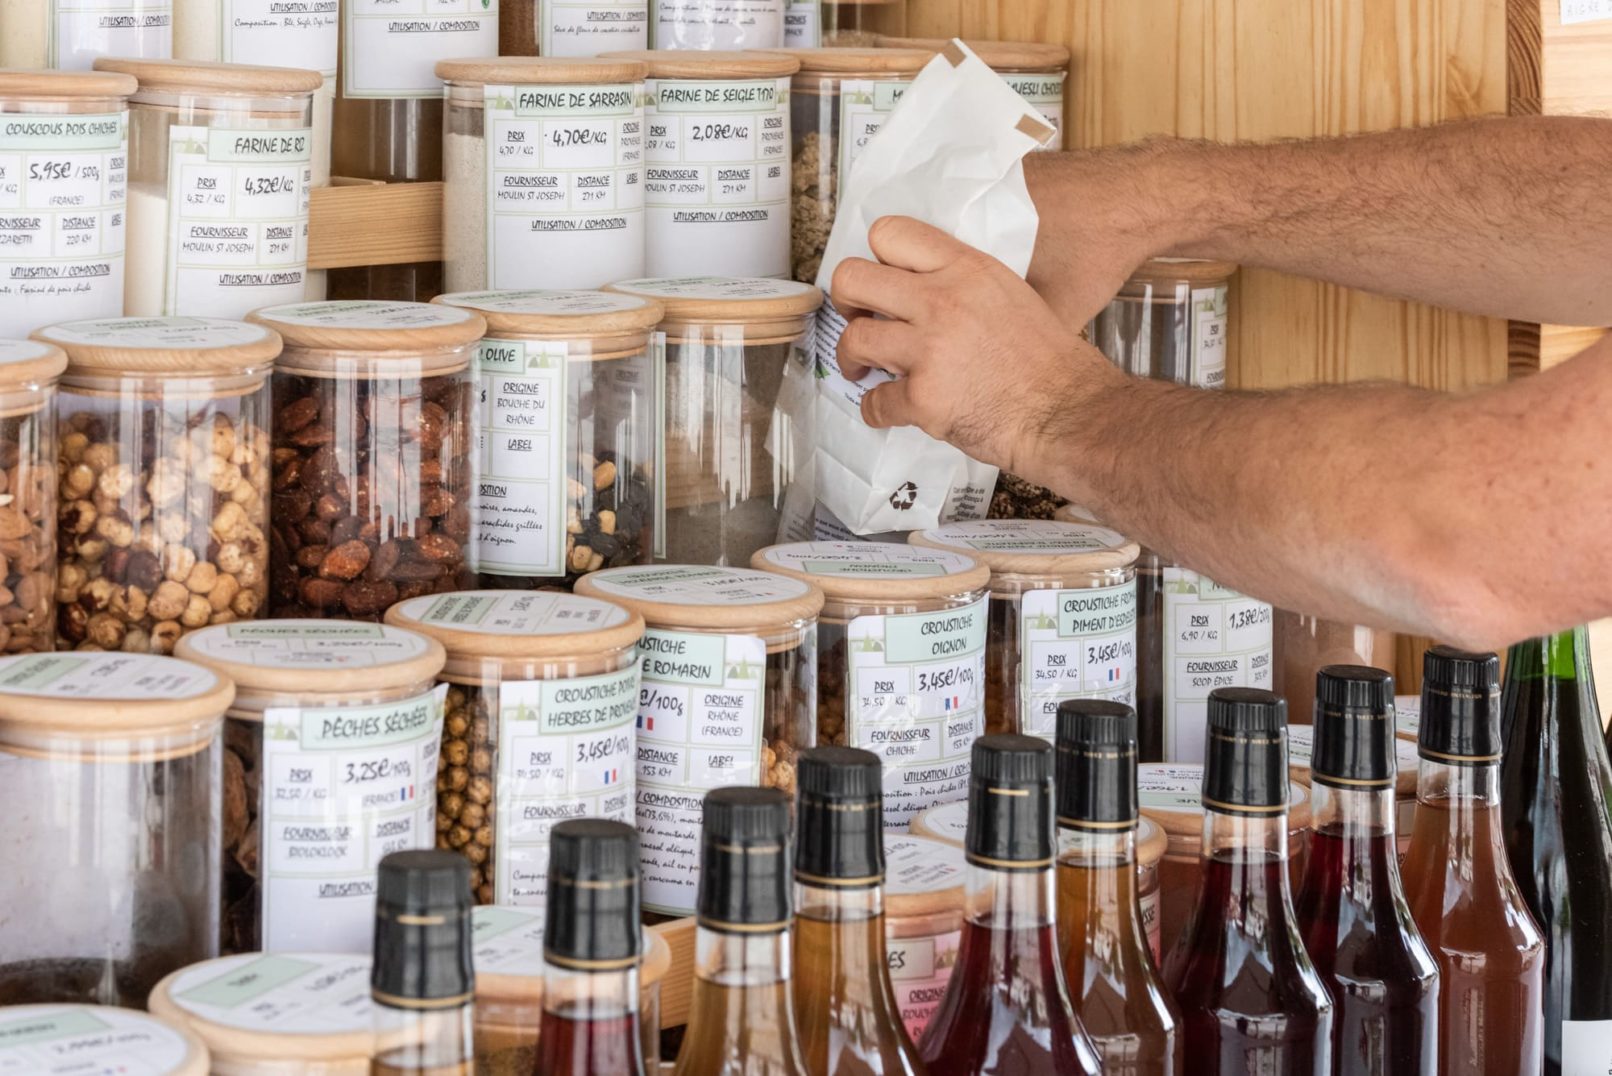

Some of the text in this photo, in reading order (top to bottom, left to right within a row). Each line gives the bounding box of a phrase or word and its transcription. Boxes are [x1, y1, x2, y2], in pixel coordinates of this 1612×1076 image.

[270, 2, 308, 13] UTILISATION
[234, 18, 278, 28] Composition
[388, 20, 480, 32] UTILISATION COMPOSITION
[519, 90, 632, 108] FARINE DE SARRASIN
[661, 87, 774, 103] FARINE DE SEIGLE T170
[6, 121, 117, 135] COUSCOUS POIS CHICHES
[650, 125, 667, 137] PRIX
[692, 124, 748, 141] 2,08€/KG
[507, 131, 525, 142] PRIX
[552, 129, 607, 147] 4,70€/KG
[235, 137, 277, 153] FARINE
[280, 137, 293, 153] DE
[523, 146, 534, 156] KG
[665, 140, 676, 150] KG
[29, 162, 71, 181] 5,95€
[646, 169, 699, 181] FOURNISSEUR
[717, 169, 750, 181] DISTANCE
[197, 177, 217, 189] PRIX
[245, 176, 294, 195] 4,32€/KG
[503, 175, 558, 188] FOURNISSEUR
[577, 175, 610, 187] DISTANCE
[5, 183, 18, 193] KG
[669, 184, 676, 192] ST
[677, 183, 705, 193] JOSEPH
[213, 194, 225, 204] KG
[497, 191, 565, 201] MOULIN ST JOSEPH
[62, 216, 96, 229] DISTANCE
[672, 209, 769, 223] UTILISATION COMPOSITION
[531, 217, 627, 231] UTILISATION COMPOSITION
[82, 234, 92, 244] KM
[190, 226, 248, 239] FOURNISSEUR
[266, 226, 293, 239] DISTANCE
[182, 242, 254, 252] MOULIN ST JOSEPH
[10, 264, 111, 279] UTILISATION COMPOSITION
[219, 273, 263, 286] UTILISATION
[503, 381, 540, 394] ORIGINE
[497, 399, 545, 410] BOUCHE DU
[506, 413, 535, 425] RHÔNE
[507, 438, 533, 451] LABEL
[1064, 596, 1119, 613] CROUSTICHE
[920, 613, 973, 636] CROUSTICHE
[1072, 616, 1107, 633] PIMENT
[1190, 614, 1210, 627] PRIX
[1206, 630, 1218, 641] KG
[931, 637, 968, 656] OIGNON
[1047, 654, 1067, 667] PRIX
[1186, 659, 1239, 673] FOURNISSEUR
[653, 660, 711, 679] ROMARIN
[1035, 668, 1078, 680] 34,50 KG
[874, 680, 895, 694] PRIX
[1192, 674, 1234, 688] SCOP ÉPICE
[555, 683, 617, 704] CROUSTICHE
[704, 694, 744, 708] ORIGINE
[322, 705, 428, 738] PÊCHES SÉCHÉES
[548, 707, 607, 728] HERBES DE
[707, 709, 740, 722] RHÔNE
[701, 726, 744, 738] (FRANCE)
[947, 718, 974, 738] DISTANCE
[870, 728, 931, 743] FOURNISSEUR
[637, 748, 678, 765] DISTANCE
[885, 744, 917, 757] CHICHE
[530, 751, 551, 766] PRIX
[289, 768, 313, 782] PRIX
[658, 765, 672, 778] KM
[903, 768, 948, 784] UTILISATION
[643, 792, 704, 811] COMPOSITION
[646, 825, 697, 841] de moutarde,
[319, 880, 374, 898] UTILISATION
